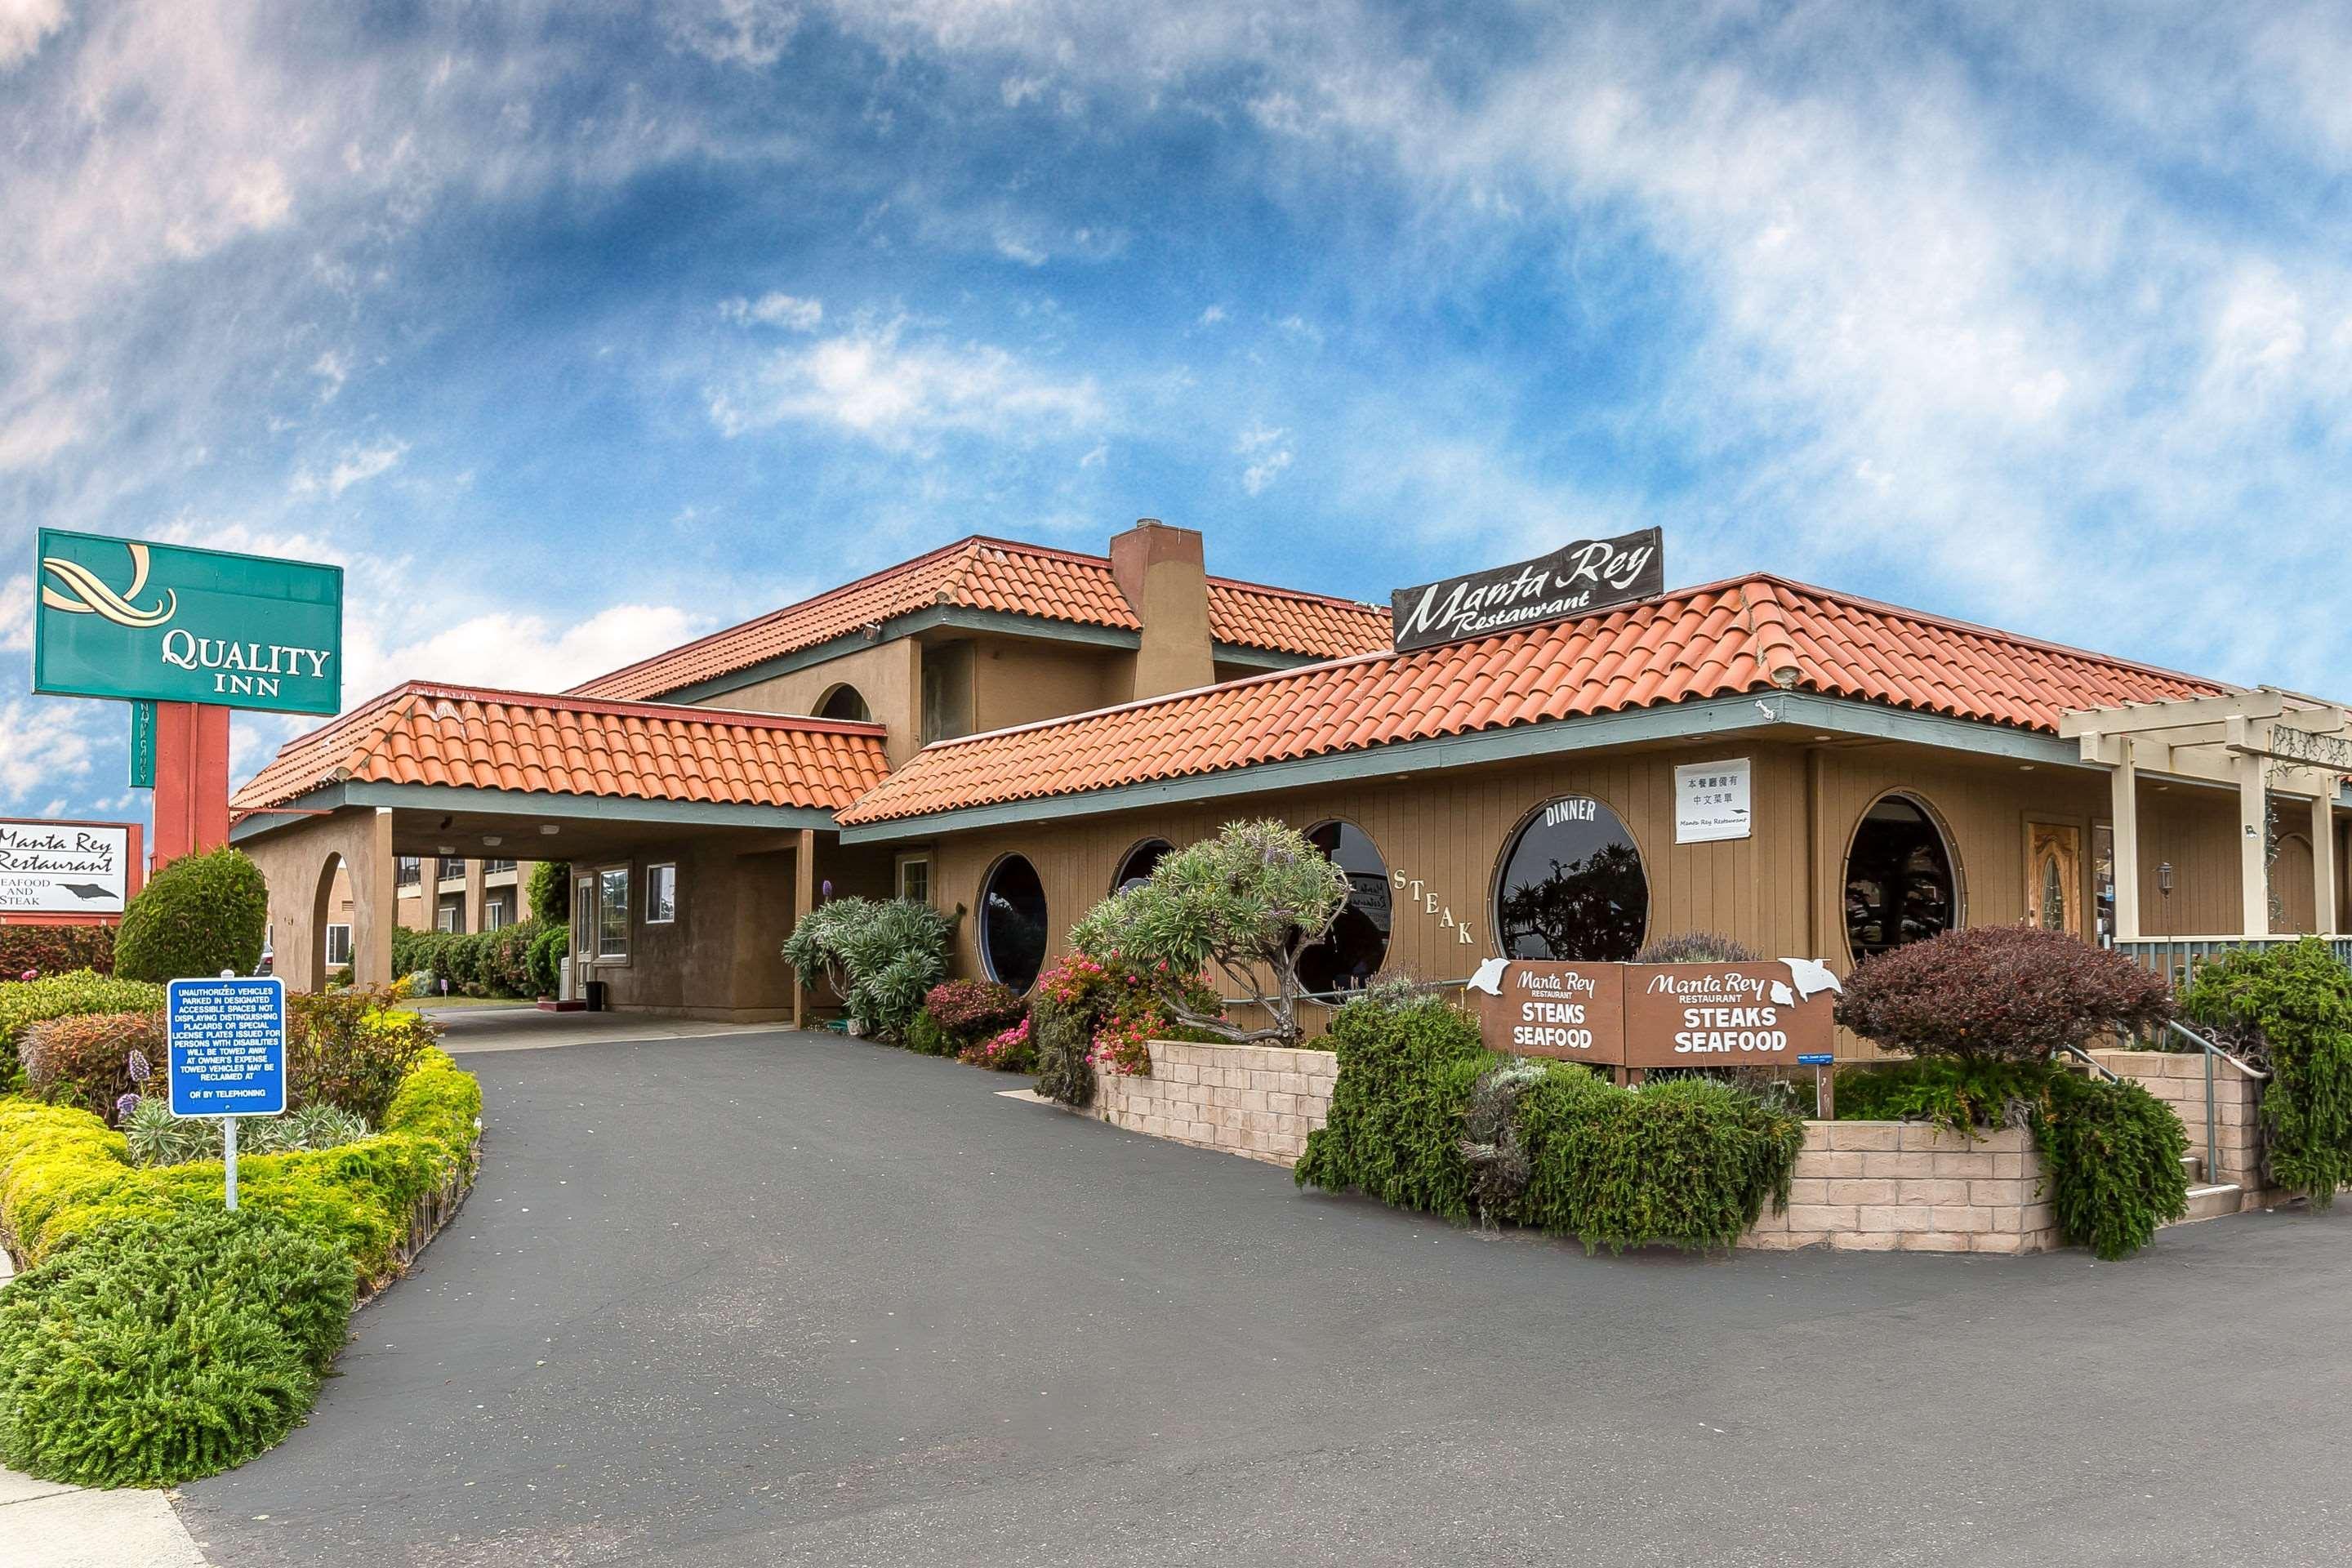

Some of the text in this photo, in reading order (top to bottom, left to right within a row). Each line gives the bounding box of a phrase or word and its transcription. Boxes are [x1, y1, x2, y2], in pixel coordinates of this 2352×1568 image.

[1397, 542, 1654, 643] Manta Rey
[1450, 591, 1589, 638] Restaurant
[163, 629, 330, 678] QUALITY
[214, 673, 280, 697] INN
[1693, 793, 1733, 805] 中文菜單
[1546, 800, 1596, 826] DINNER
[0, 828, 112, 858] Manta Rey
[0, 850, 112, 872] Restaurant
[1, 878, 51, 887] EAFOOD
[0, 896, 40, 905] STEAK
[1394, 870, 1474, 944] STEAK
[1517, 970, 1595, 999] Manta Rey
[1532, 991, 1572, 1000] RESTAURANT
[1646, 973, 1765, 1000] Manta Rey
[1679, 994, 1742, 1004] RESTAURANT
[1522, 1002, 1585, 1024] STEAKS
[1683, 1007, 1777, 1028] STEAKS
[1513, 1027, 1592, 1049] SEAFOOD
[1674, 1031, 1787, 1053] SEAFOOD
[216, 1089, 265, 1098] TELEPHONING
